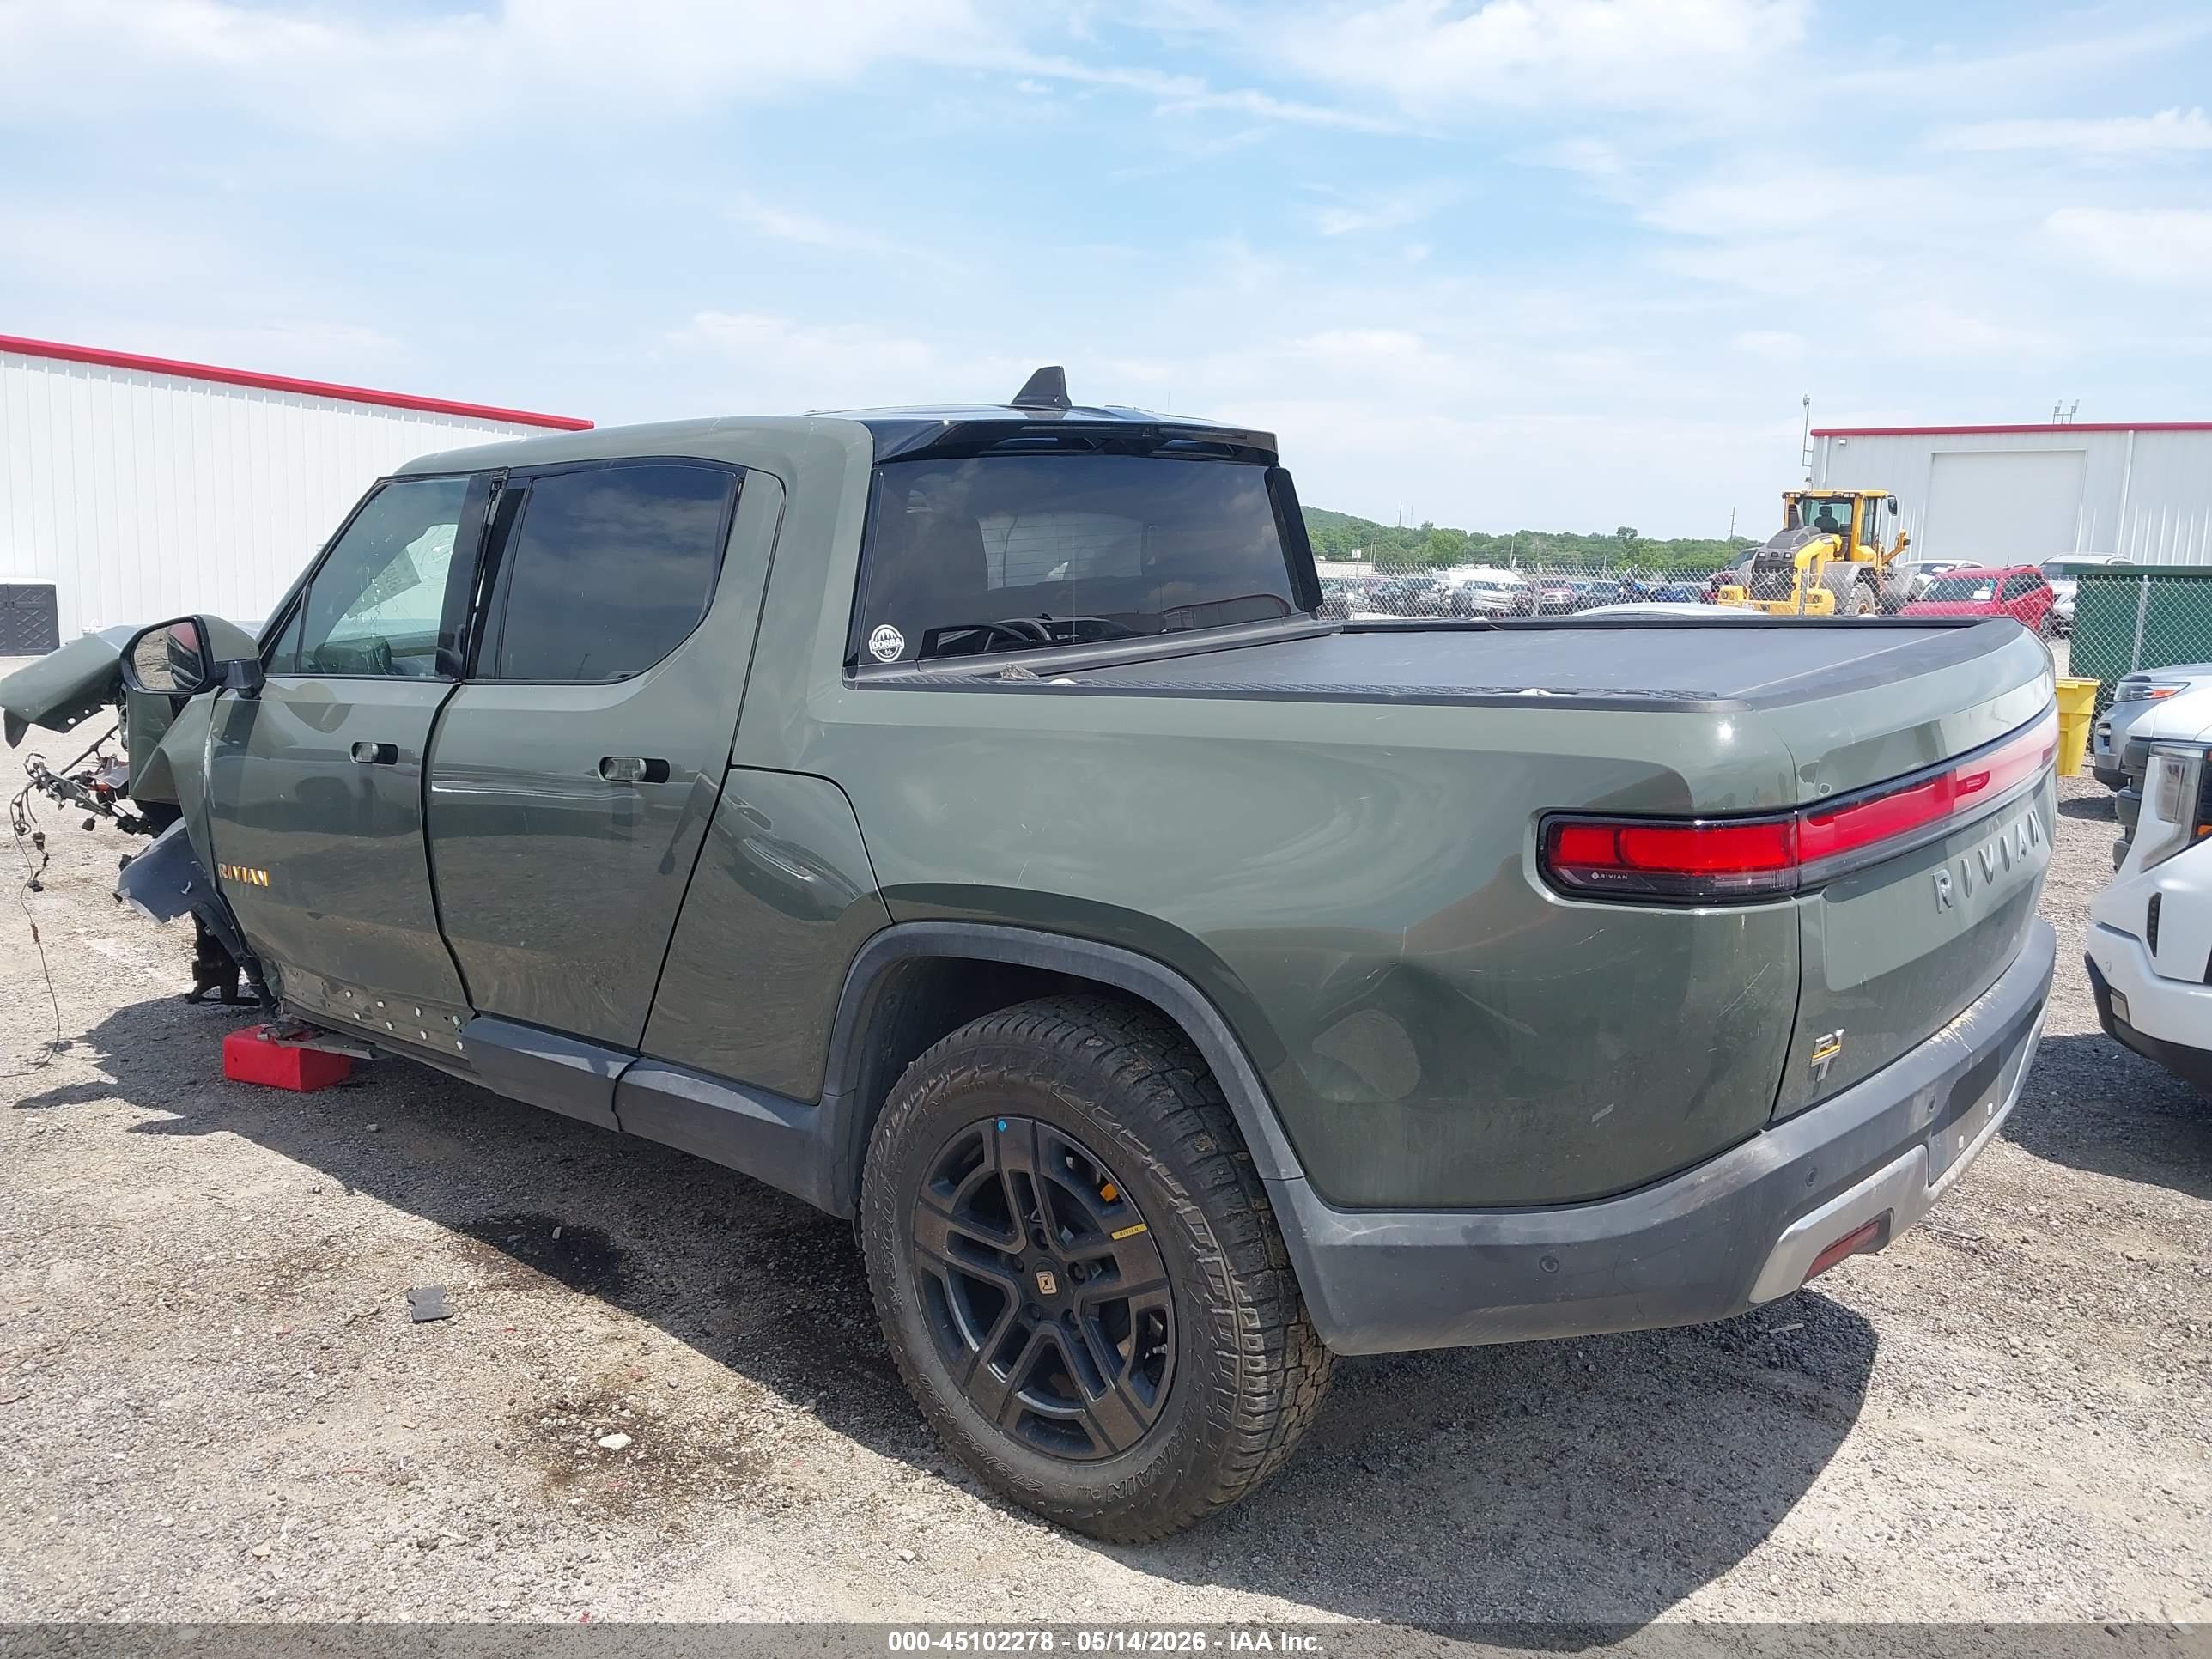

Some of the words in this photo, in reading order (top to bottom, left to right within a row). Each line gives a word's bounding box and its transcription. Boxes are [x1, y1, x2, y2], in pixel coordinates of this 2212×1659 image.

[872, 637, 902, 650] DORBA
[1930, 809, 2039, 914] RIVIAN
[218, 863, 269, 887] RIVIAN
